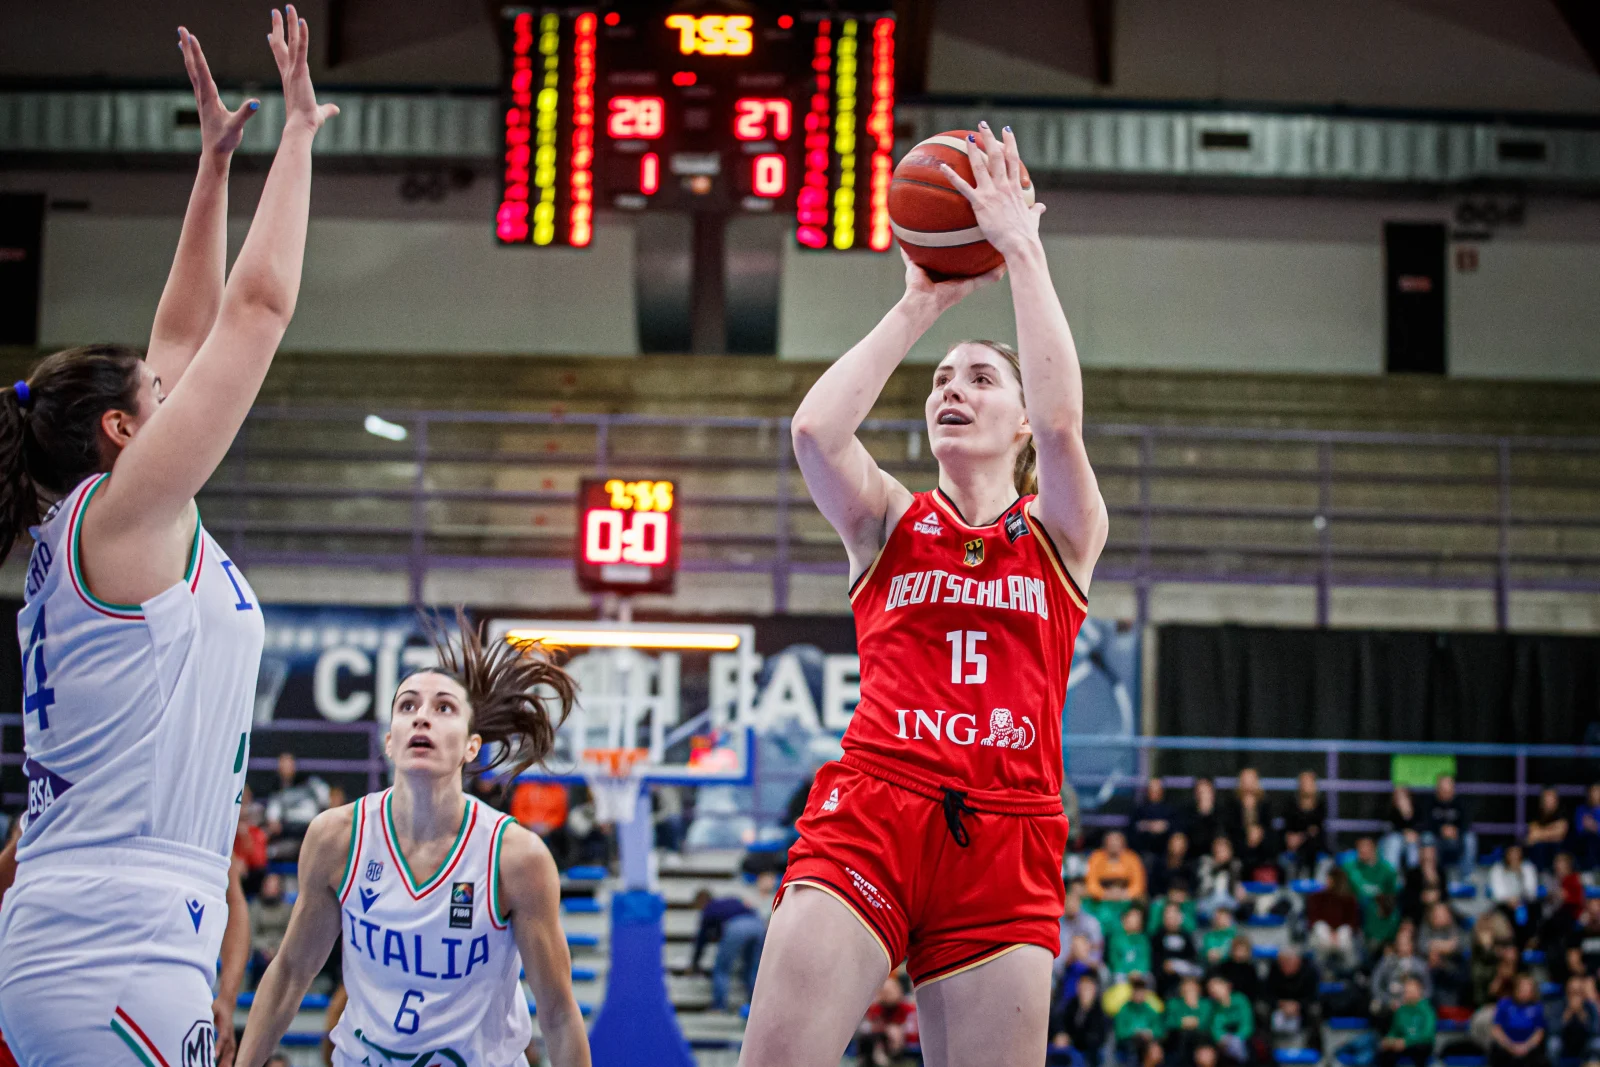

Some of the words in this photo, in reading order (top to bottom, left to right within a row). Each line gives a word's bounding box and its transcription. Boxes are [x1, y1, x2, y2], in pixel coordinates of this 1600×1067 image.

[608, 96, 664, 138] 28
[734, 98, 792, 140] 27
[641, 152, 659, 194] 1
[753, 154, 787, 197] 0
[913, 521, 944, 536] PEAK
[1007, 518, 1022, 534] FIBA
[884, 569, 1049, 621] DEUTSCHLAND
[946, 629, 987, 685] 15
[894, 709, 979, 746] ING
[452, 907, 470, 918] FIBA
[344, 908, 489, 980] ITALIA
[394, 989, 425, 1035] 6
